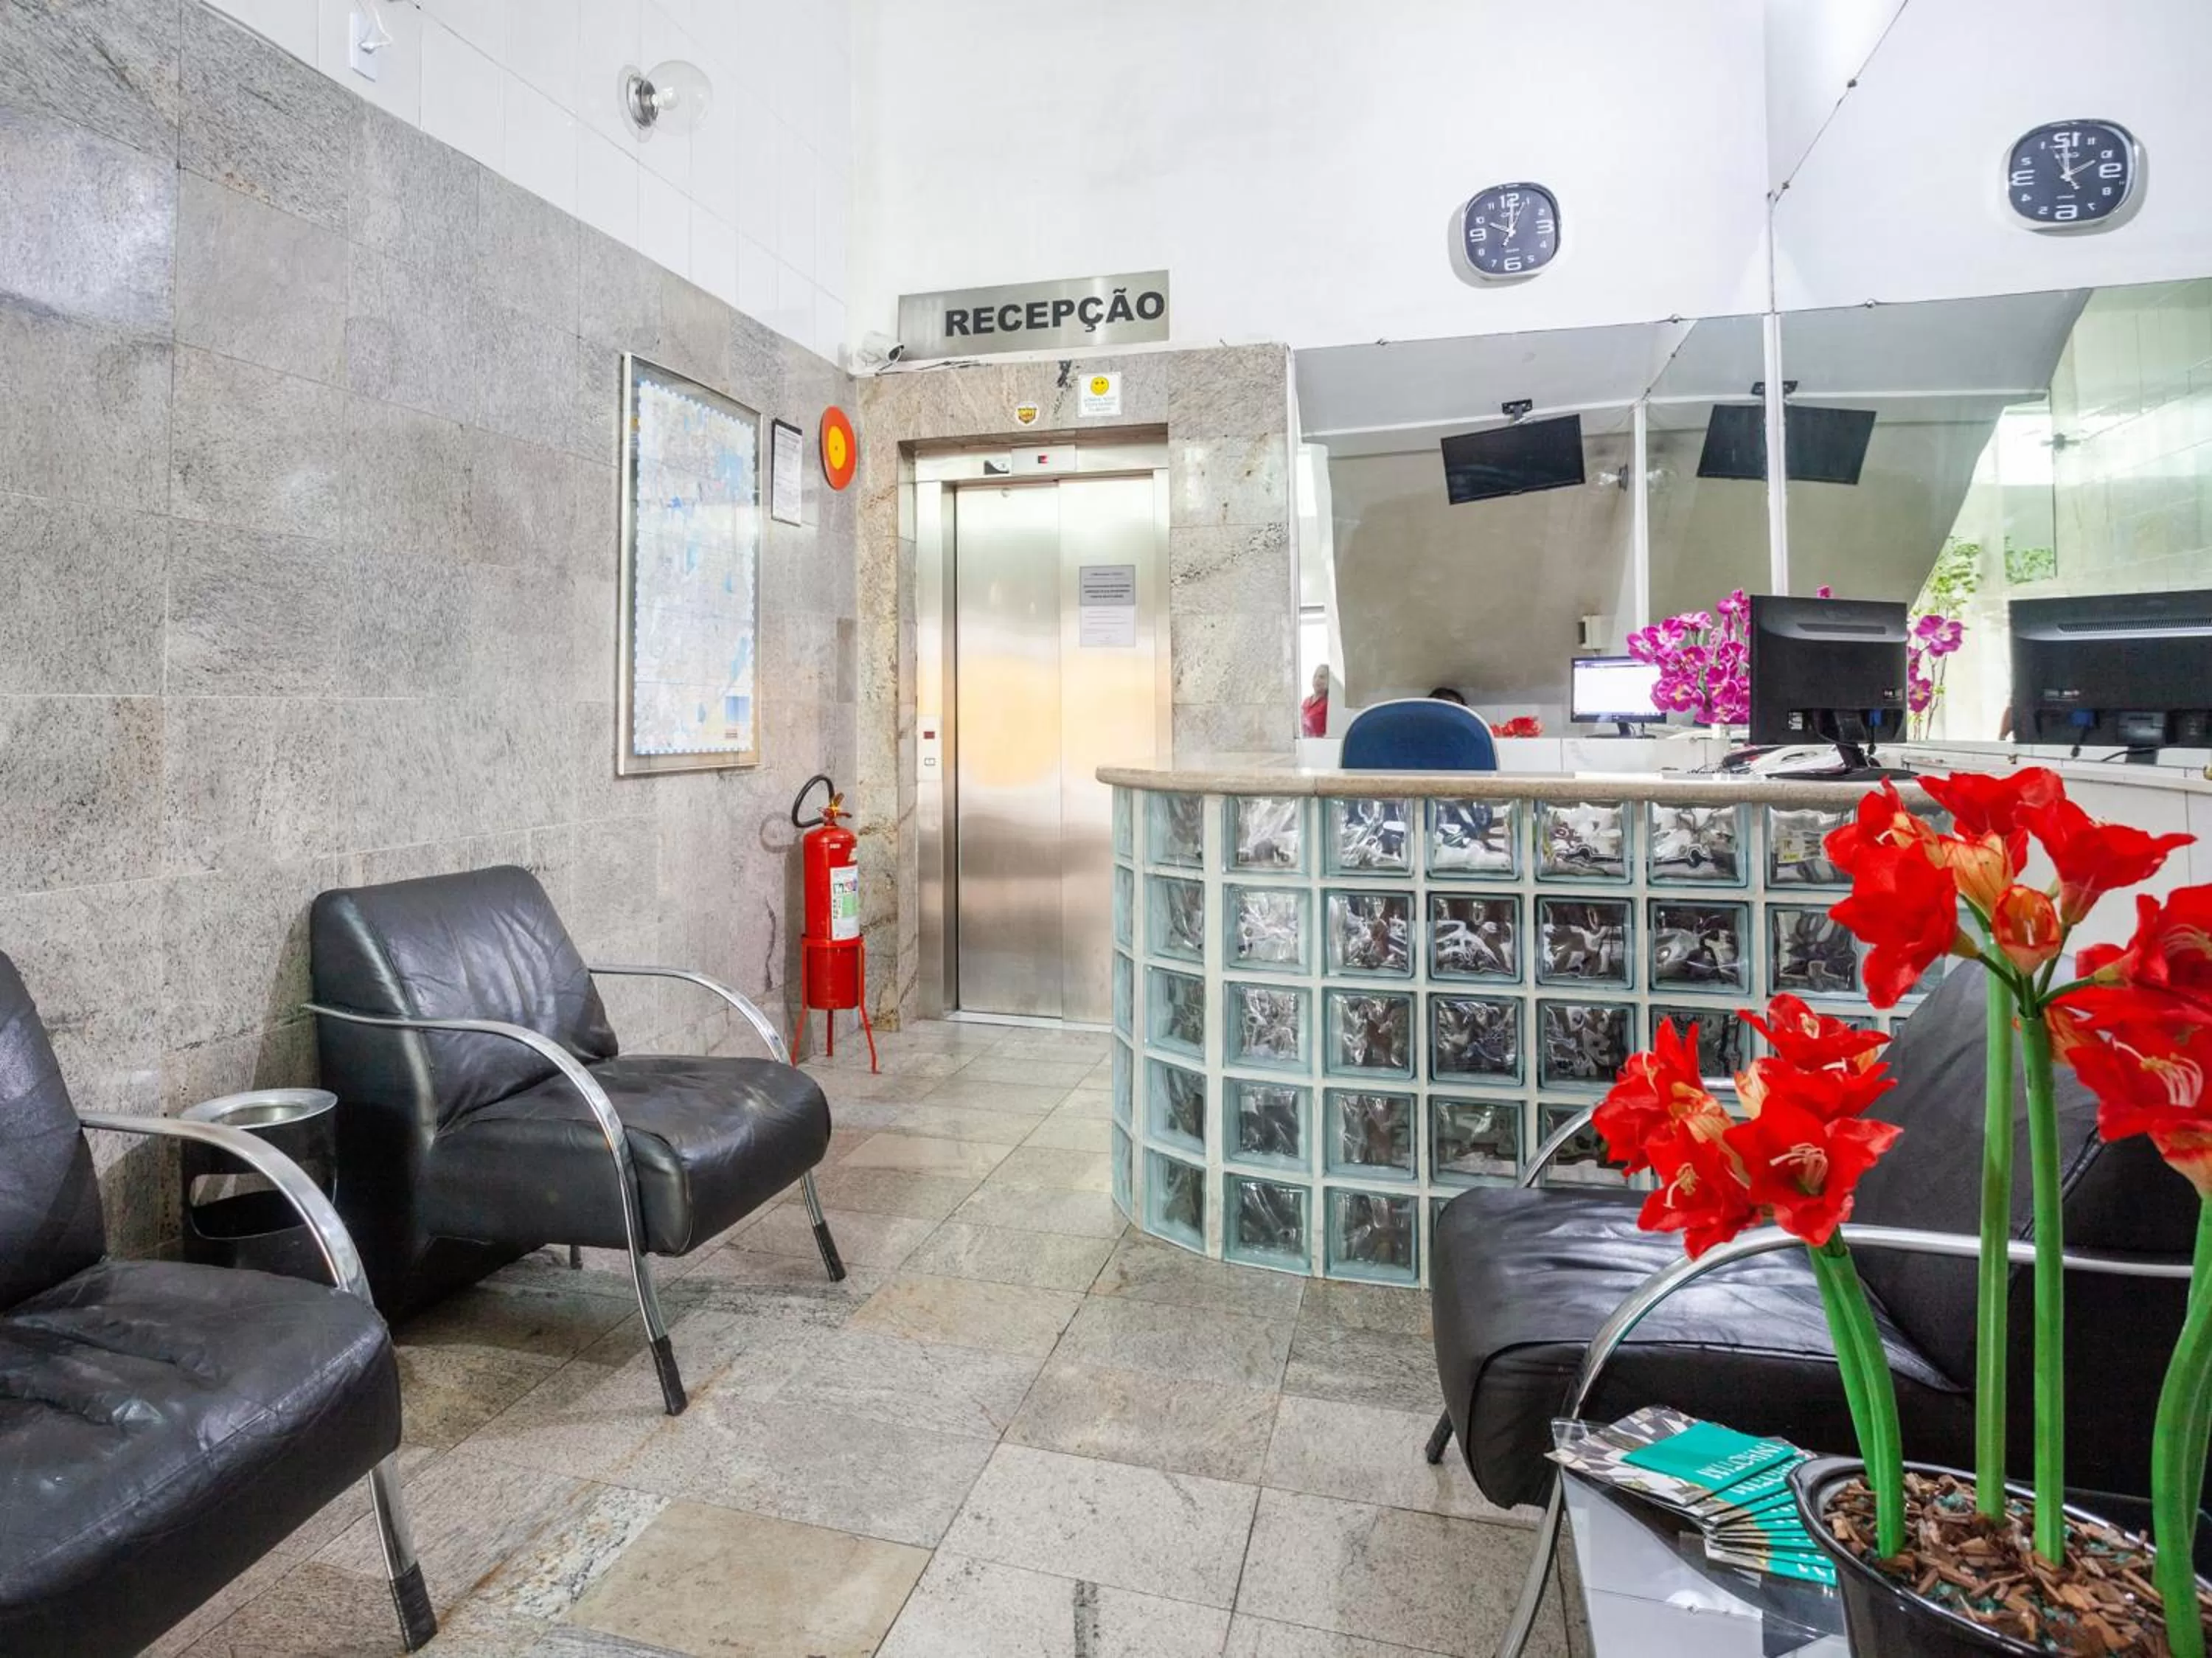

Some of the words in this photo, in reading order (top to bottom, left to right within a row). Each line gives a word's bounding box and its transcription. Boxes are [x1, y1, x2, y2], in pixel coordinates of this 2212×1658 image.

[1499, 192, 1520, 208] 12
[1535, 220, 1554, 235] 3
[1470, 228, 1486, 242] 9
[1491, 259, 1498, 267] 7
[1504, 257, 1522, 271] 6
[945, 287, 1165, 337] RECEPÇÃO
